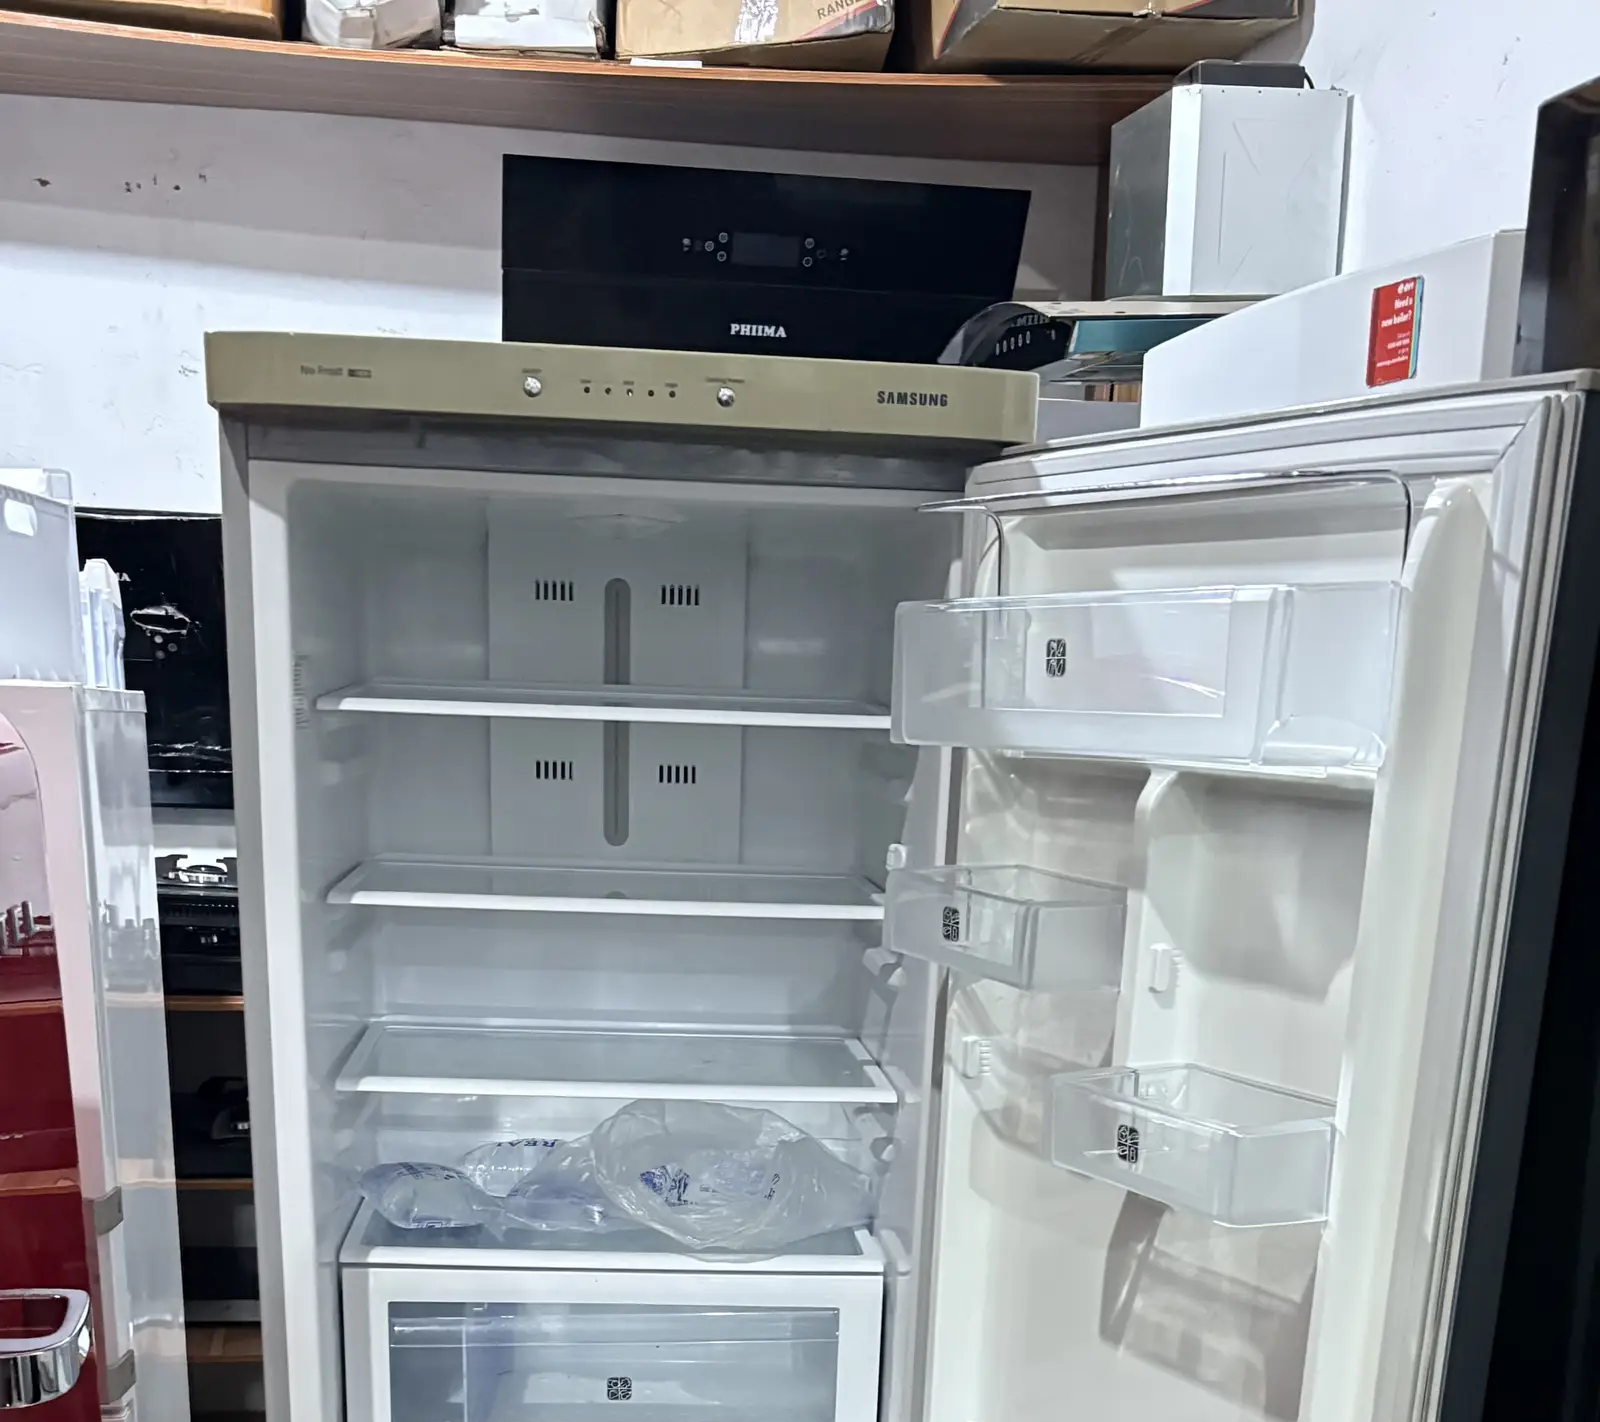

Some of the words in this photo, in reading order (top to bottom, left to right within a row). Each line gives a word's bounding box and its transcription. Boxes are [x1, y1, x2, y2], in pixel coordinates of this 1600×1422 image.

[817, 0, 864, 19] RANG
[730, 323, 787, 338] PHIIMA
[877, 390, 948, 407] SAMSUNG
